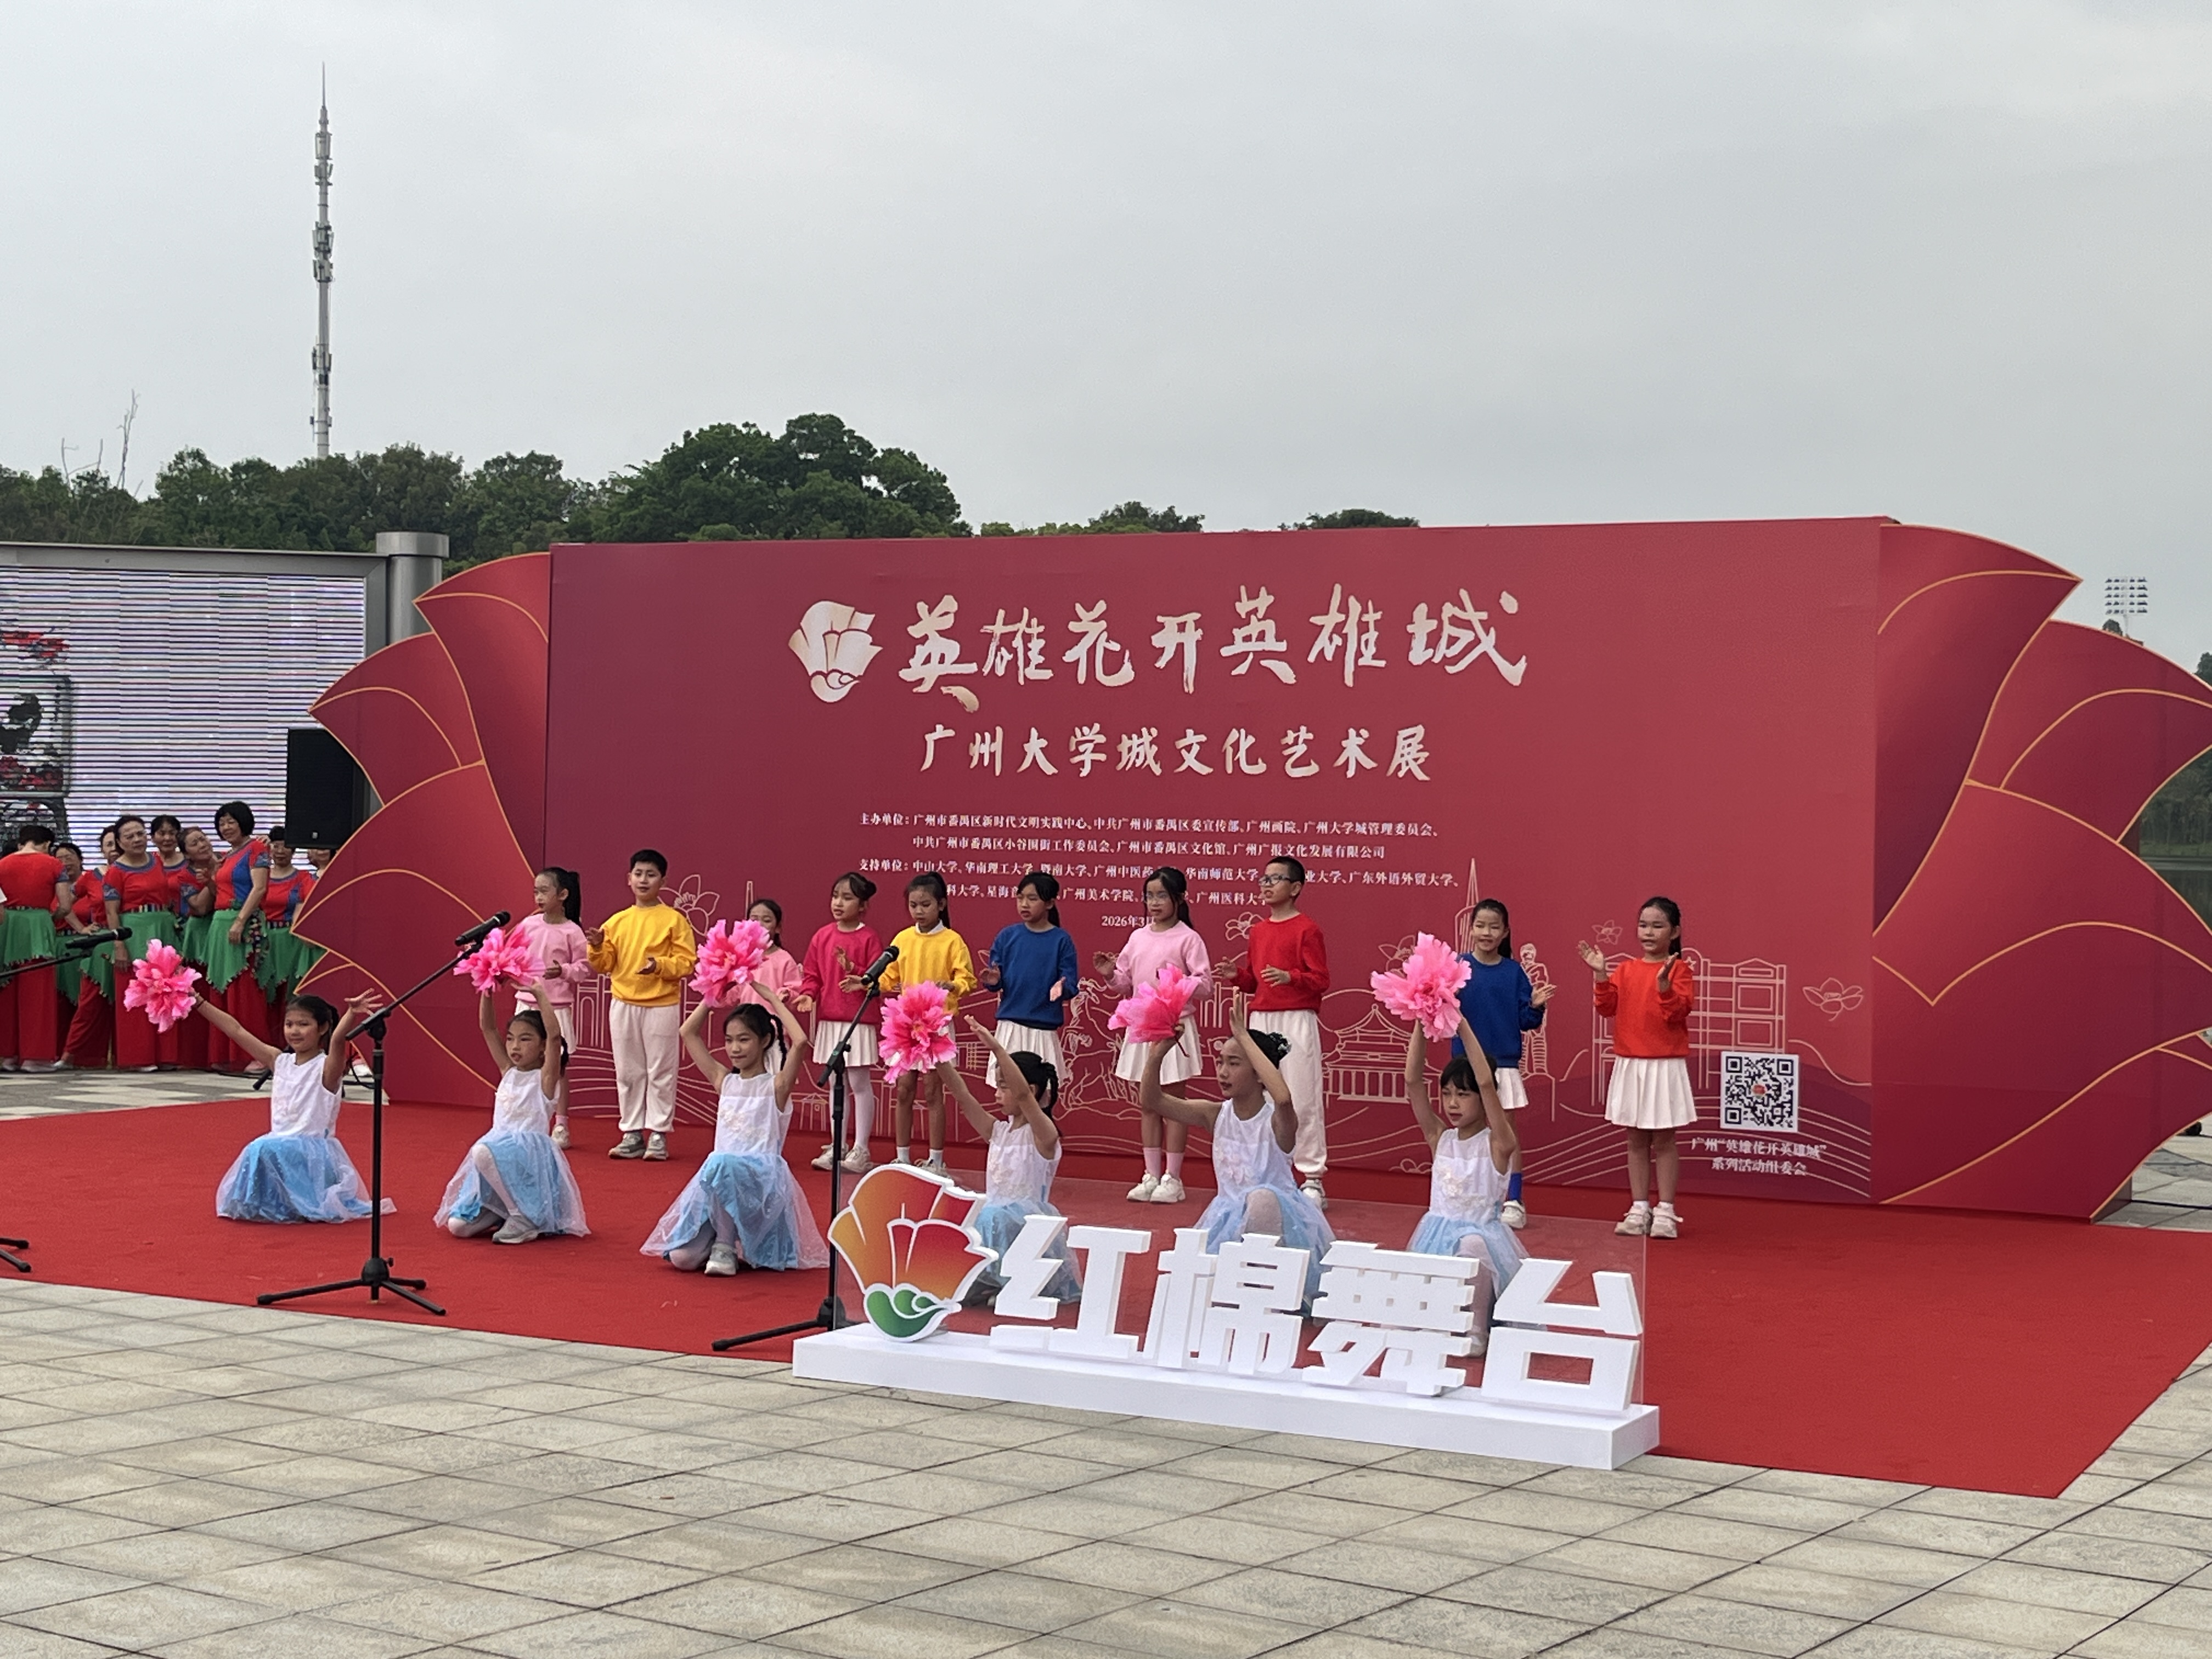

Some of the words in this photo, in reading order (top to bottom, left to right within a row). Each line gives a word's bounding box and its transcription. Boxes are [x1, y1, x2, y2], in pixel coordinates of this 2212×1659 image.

[898, 584, 1527, 712] 英雄花开英雄城
[921, 722, 1431, 780] 广州大学城文化艺术展
[1711, 1156, 1807, 1176] 系列活动组委会
[990, 1214, 1643, 1411] 红棉舞台
